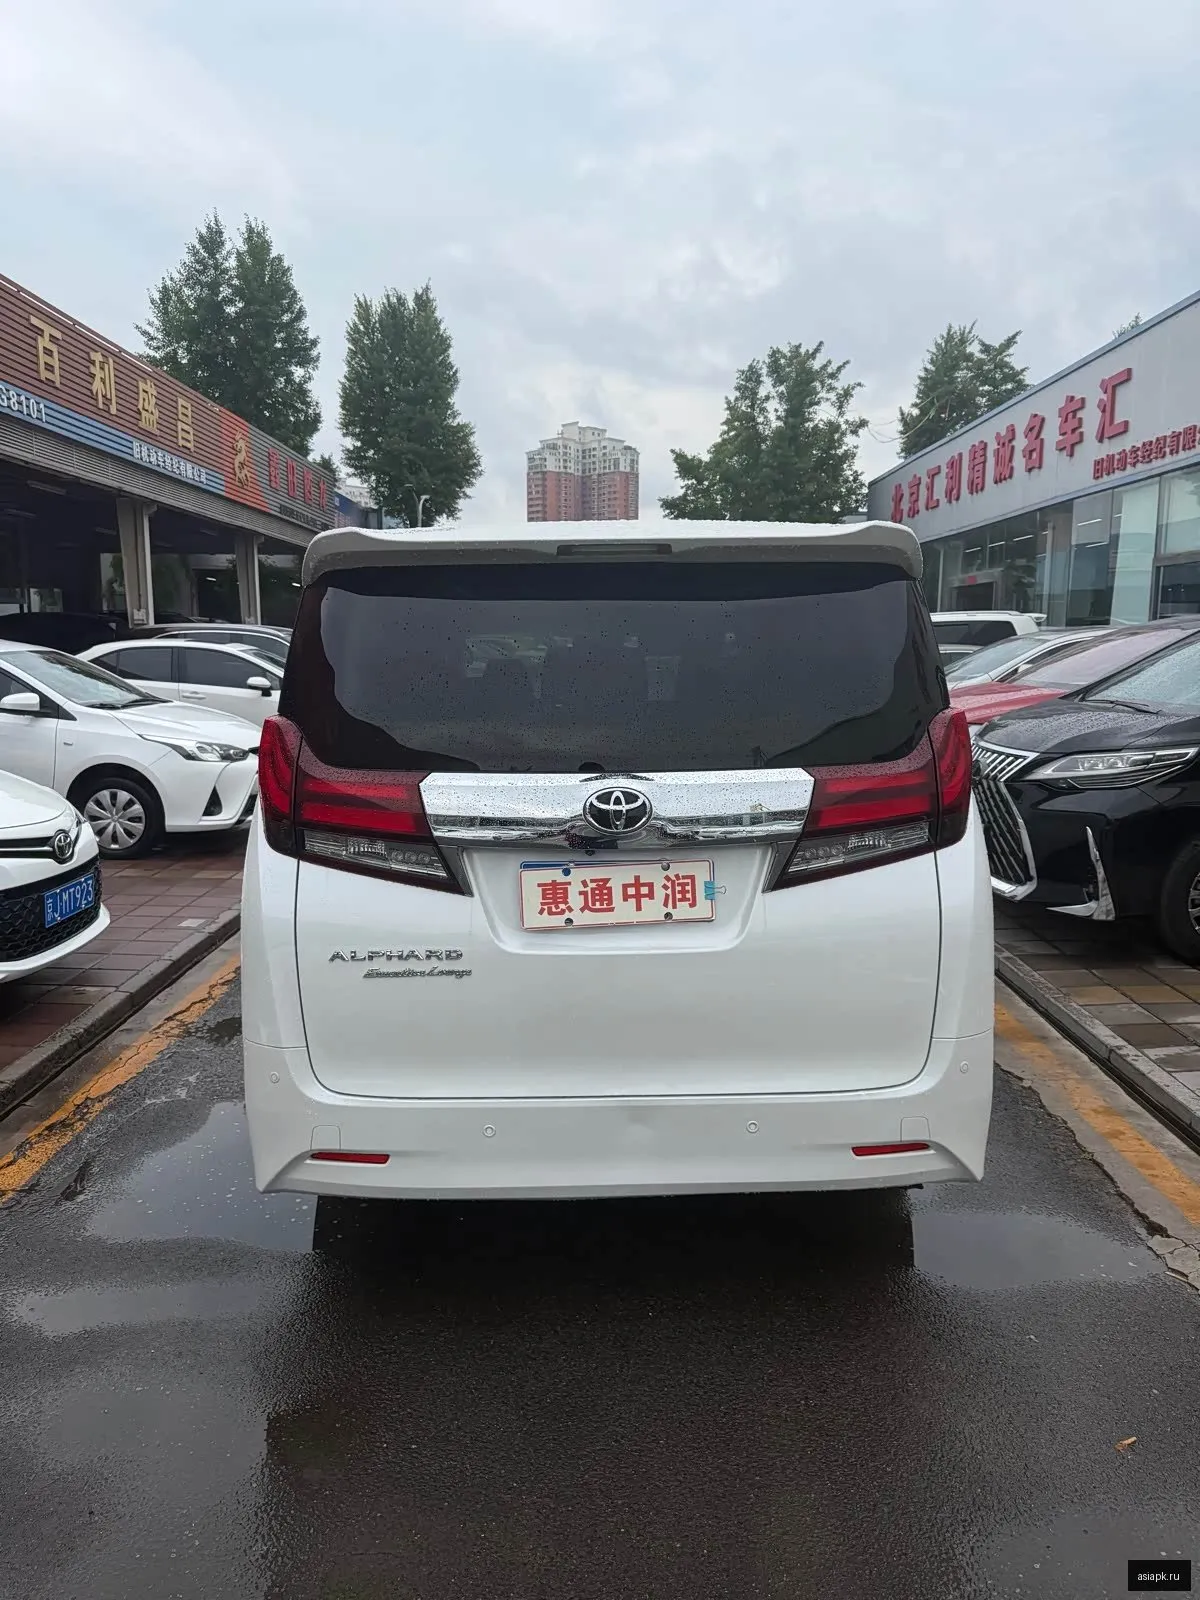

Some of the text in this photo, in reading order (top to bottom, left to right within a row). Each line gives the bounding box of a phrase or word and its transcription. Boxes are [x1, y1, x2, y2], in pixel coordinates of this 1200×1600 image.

[29, 314, 195, 452] 百利盛昌
[890, 367, 1132, 523] 北京汇利精诚名车汇
[1093, 424, 1200, 480] 旧机动车经纪有限
[537, 873, 697, 916] 惠通中润
[329, 949, 463, 962] ALPHARD
